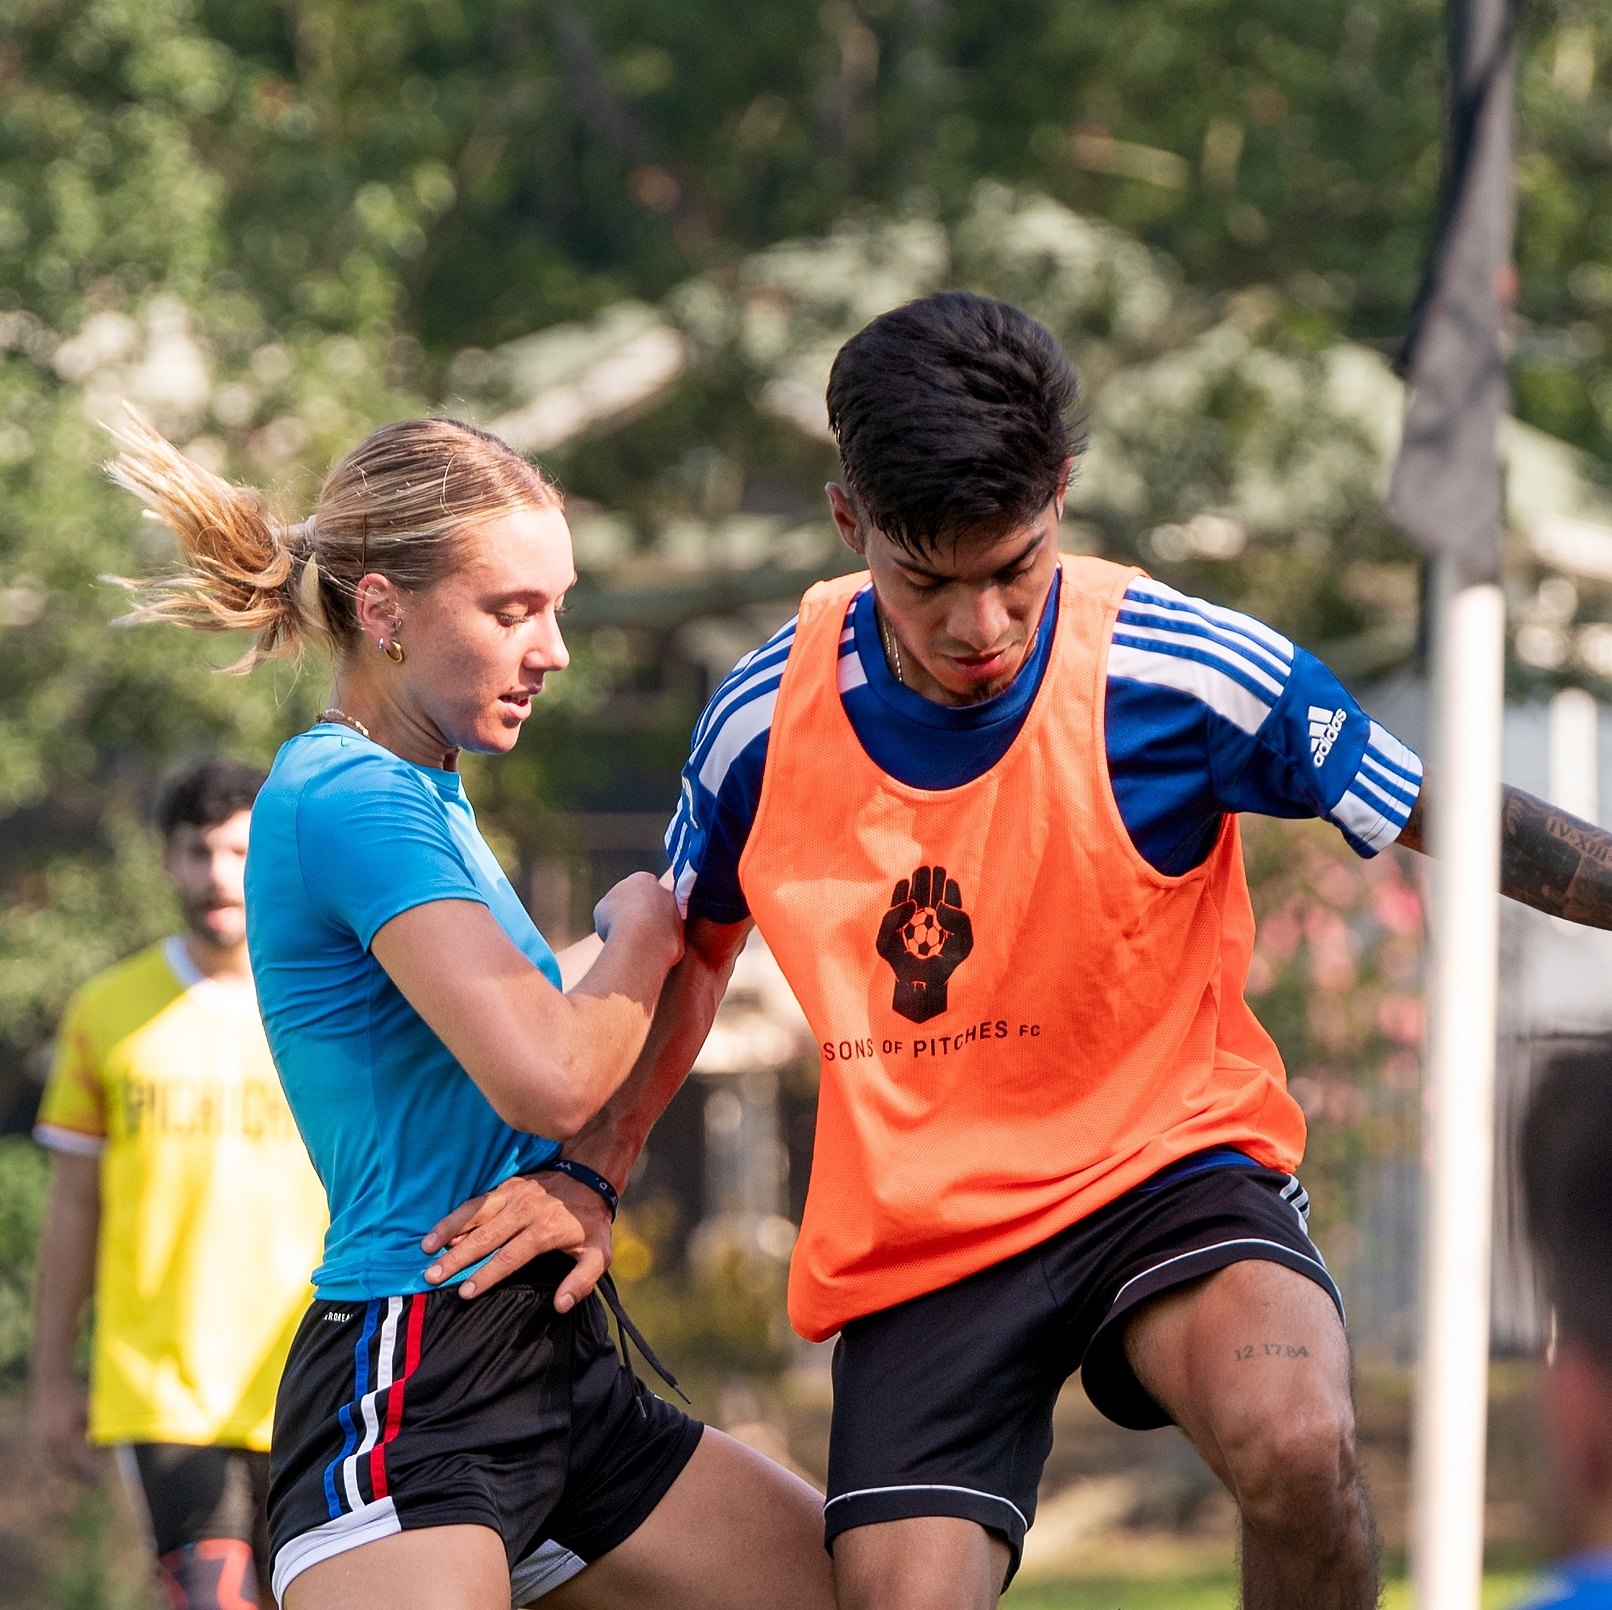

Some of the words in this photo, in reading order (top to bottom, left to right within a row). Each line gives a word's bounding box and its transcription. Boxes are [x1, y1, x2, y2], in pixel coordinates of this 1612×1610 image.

[1313, 708, 1347, 768] adidas
[823, 1038, 874, 1062] SONS
[882, 1040, 903, 1054] OF
[913, 1020, 1008, 1058] PITCHES
[1018, 1024, 1040, 1037] FC
